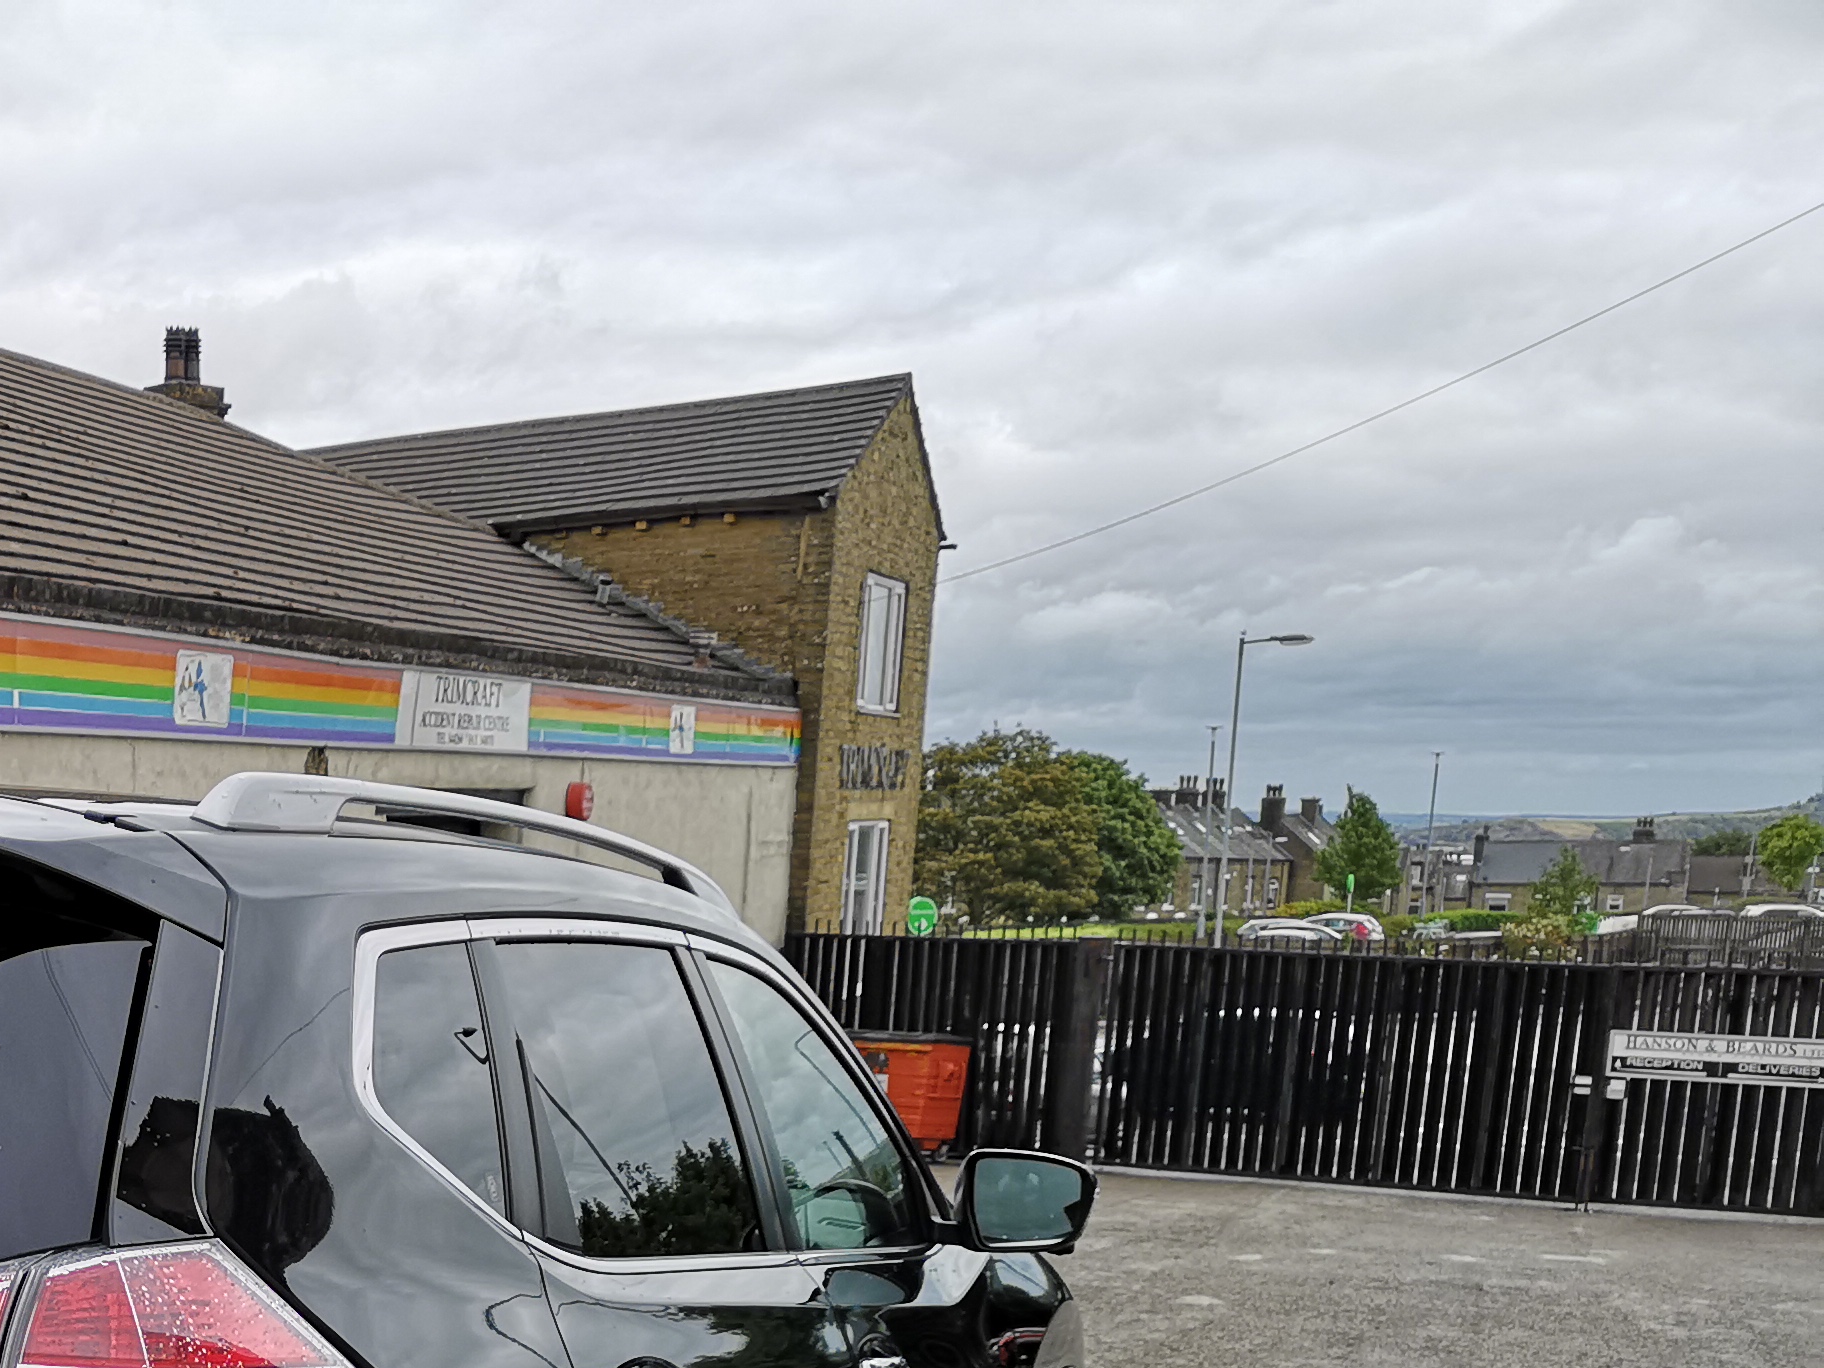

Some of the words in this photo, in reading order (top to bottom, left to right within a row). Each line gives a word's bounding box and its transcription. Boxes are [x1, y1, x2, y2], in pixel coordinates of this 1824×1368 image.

[434, 675, 503, 708] TRIMCRAFT
[1626, 1035, 1699, 1051] HANSON
[1705, 1039, 1718, 1053] &
[1725, 1041, 1798, 1057] BEARDS
[1626, 1056, 1704, 1071] RECEPTION
[1738, 1062, 1821, 1077] DELIVERIES
